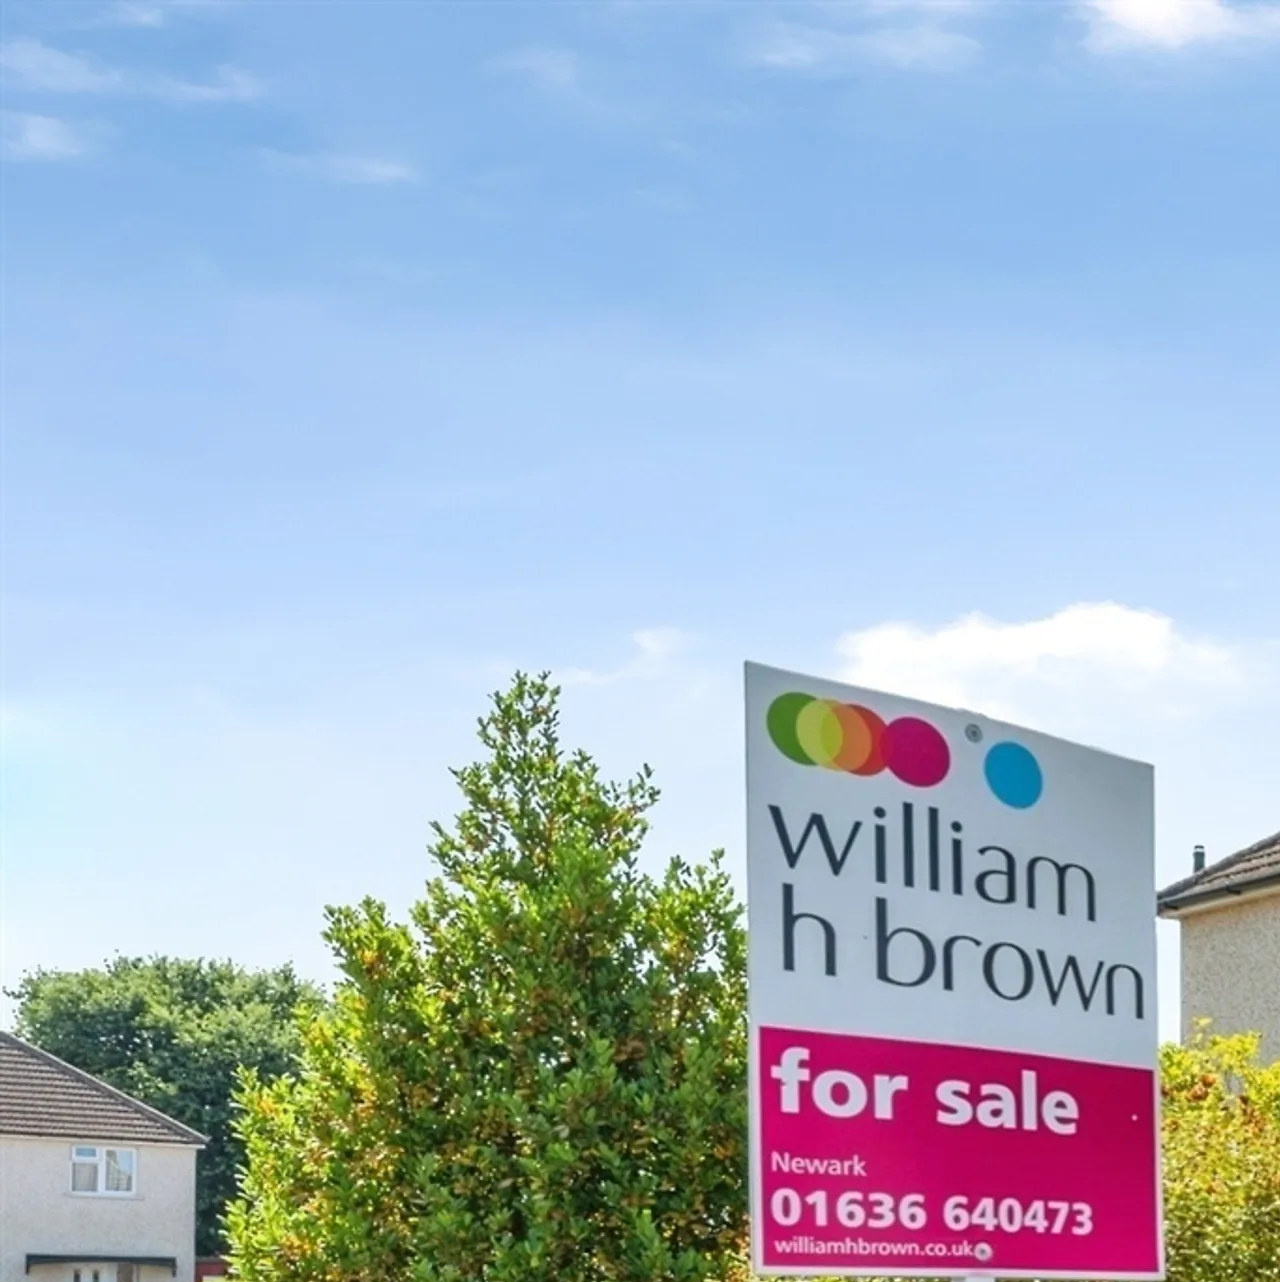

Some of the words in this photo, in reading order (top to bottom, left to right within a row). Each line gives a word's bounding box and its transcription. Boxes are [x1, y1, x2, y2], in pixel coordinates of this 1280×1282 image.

[768, 801, 1097, 922] william
[781, 883, 837, 976] h
[875, 896, 1145, 1020] brown
[770, 1047, 908, 1120] for
[935, 1070, 1079, 1135] sale
[771, 1151, 867, 1178] Newark
[770, 1188, 927, 1229] 01636
[942, 1197, 1094, 1235] 640473
[774, 1235, 974, 1259] williamhbrown.co.uk
